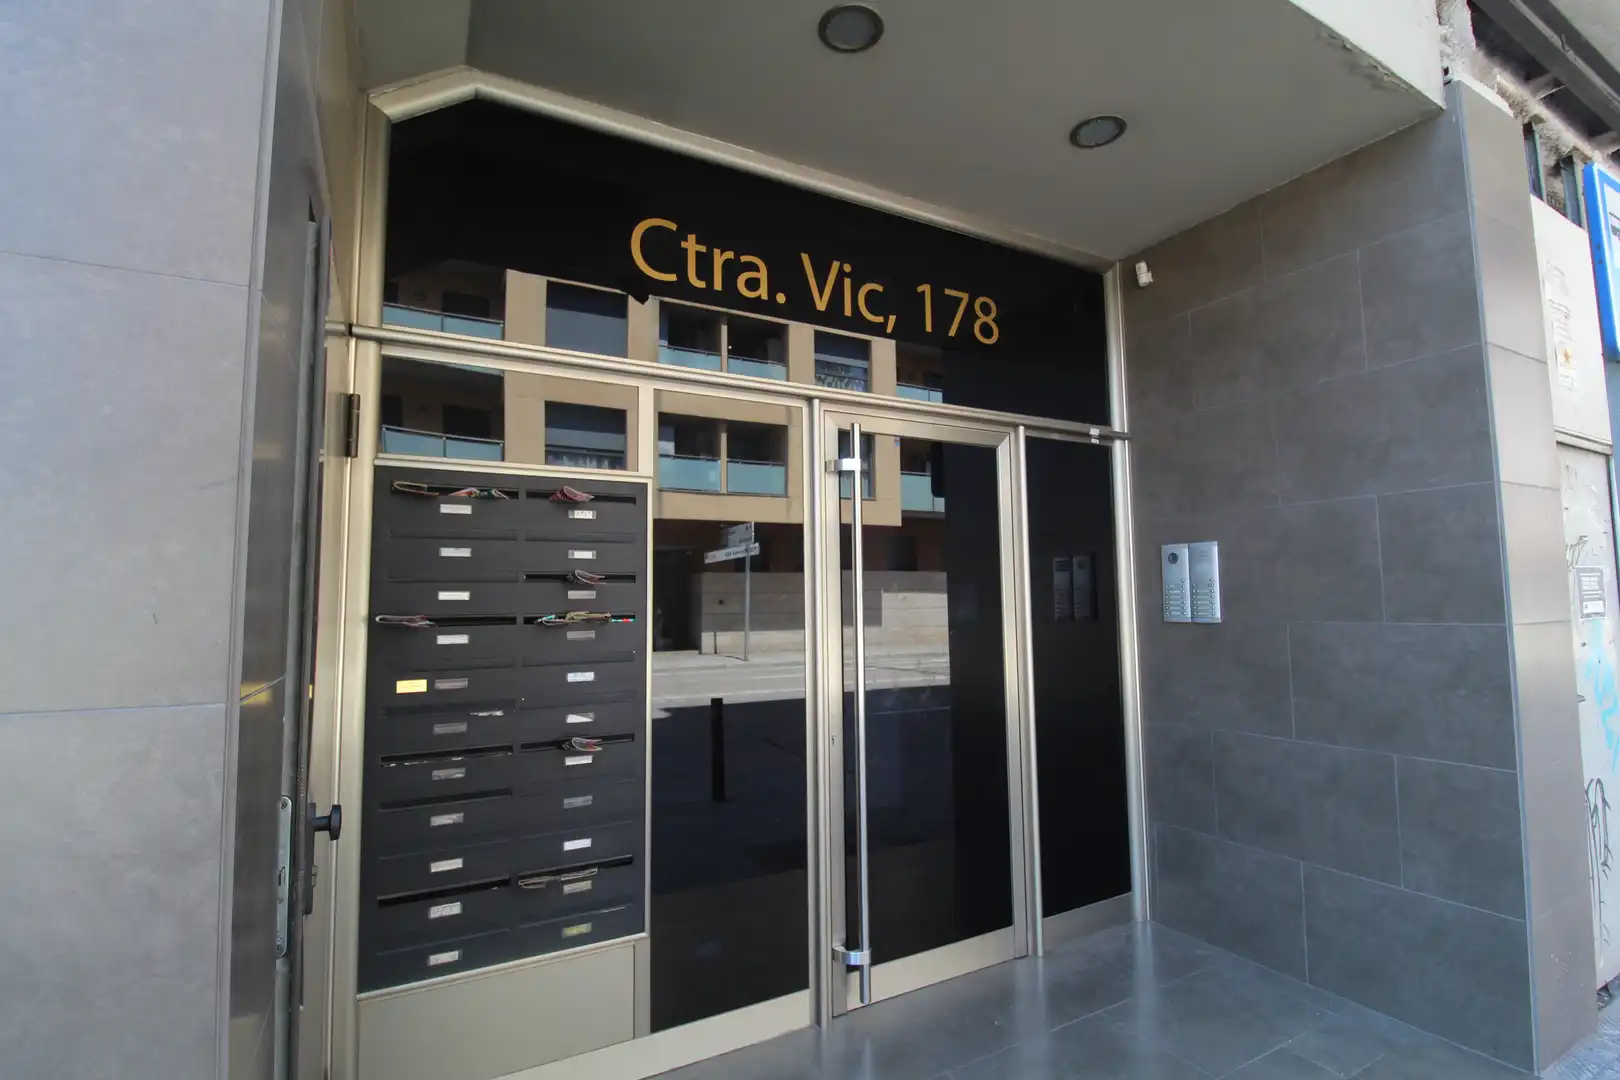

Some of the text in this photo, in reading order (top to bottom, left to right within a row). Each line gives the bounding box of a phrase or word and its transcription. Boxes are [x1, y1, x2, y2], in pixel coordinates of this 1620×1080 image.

[630, 218, 1000, 345] Ctra. Vic, 178
